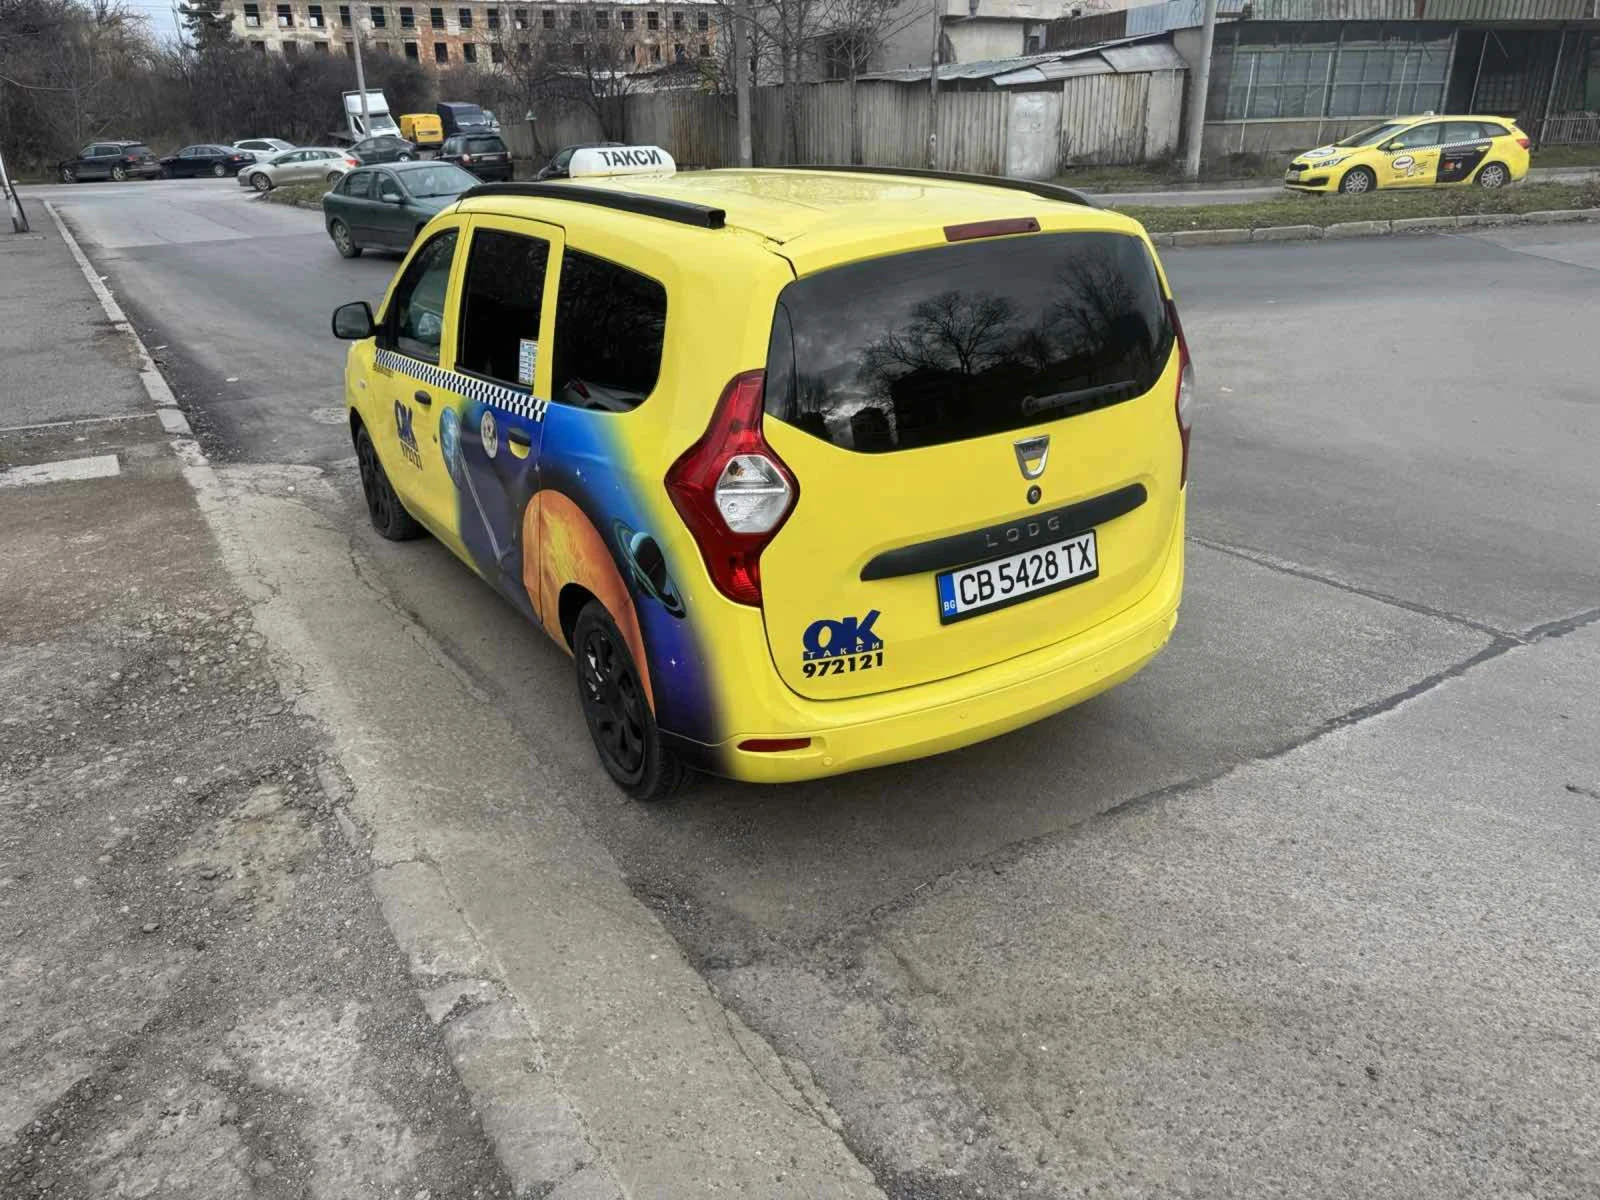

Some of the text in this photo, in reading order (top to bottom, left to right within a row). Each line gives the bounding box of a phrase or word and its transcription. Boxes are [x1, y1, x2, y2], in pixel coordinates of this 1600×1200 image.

[598, 149, 662, 167] ТАКСИ
[985, 516, 1060, 548] LODG
[959, 538, 1093, 606] CB 5428 TX
[944, 600, 956, 611] BG
[803, 609, 883, 655] OK
[808, 642, 880, 660] ТАКСИ
[803, 652, 883, 679] 972121
